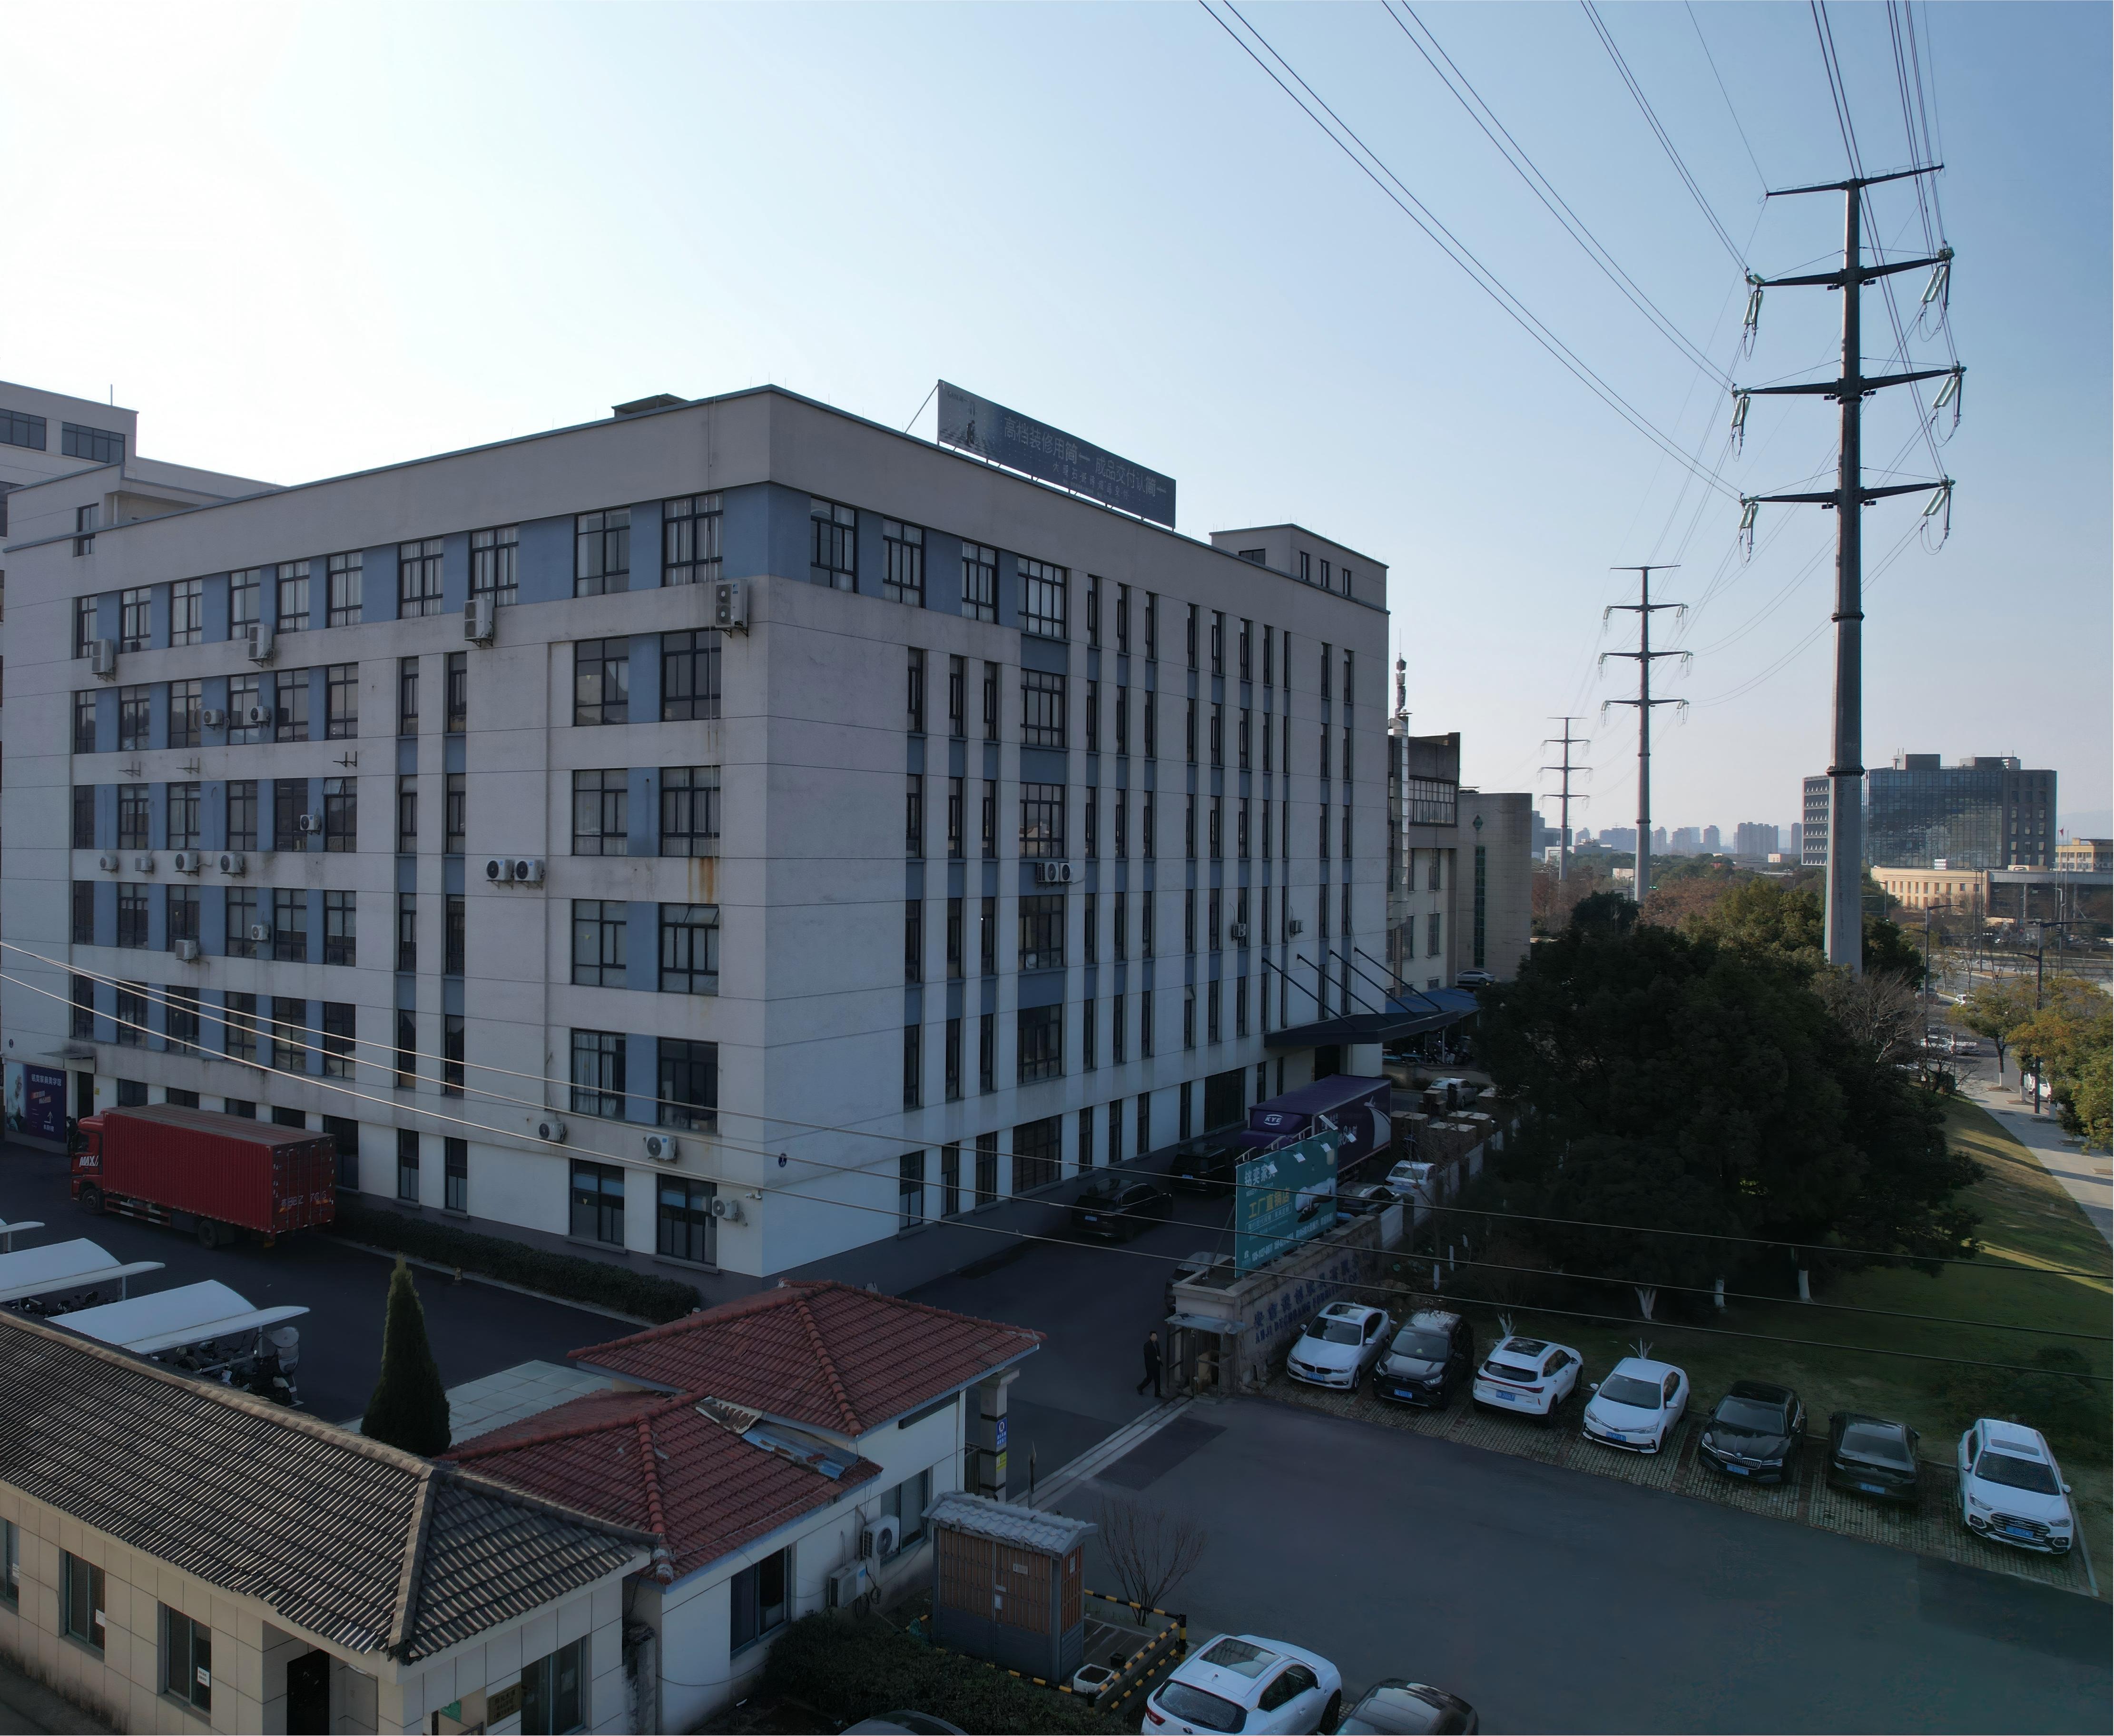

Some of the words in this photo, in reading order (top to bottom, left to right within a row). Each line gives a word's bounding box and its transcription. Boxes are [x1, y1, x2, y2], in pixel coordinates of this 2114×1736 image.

[1004, 416, 1090, 465] 高档装修用简一
[1095, 456, 1167, 496] 成品交付认简一
[1249, 1187, 1290, 1218] 工厂直销店
